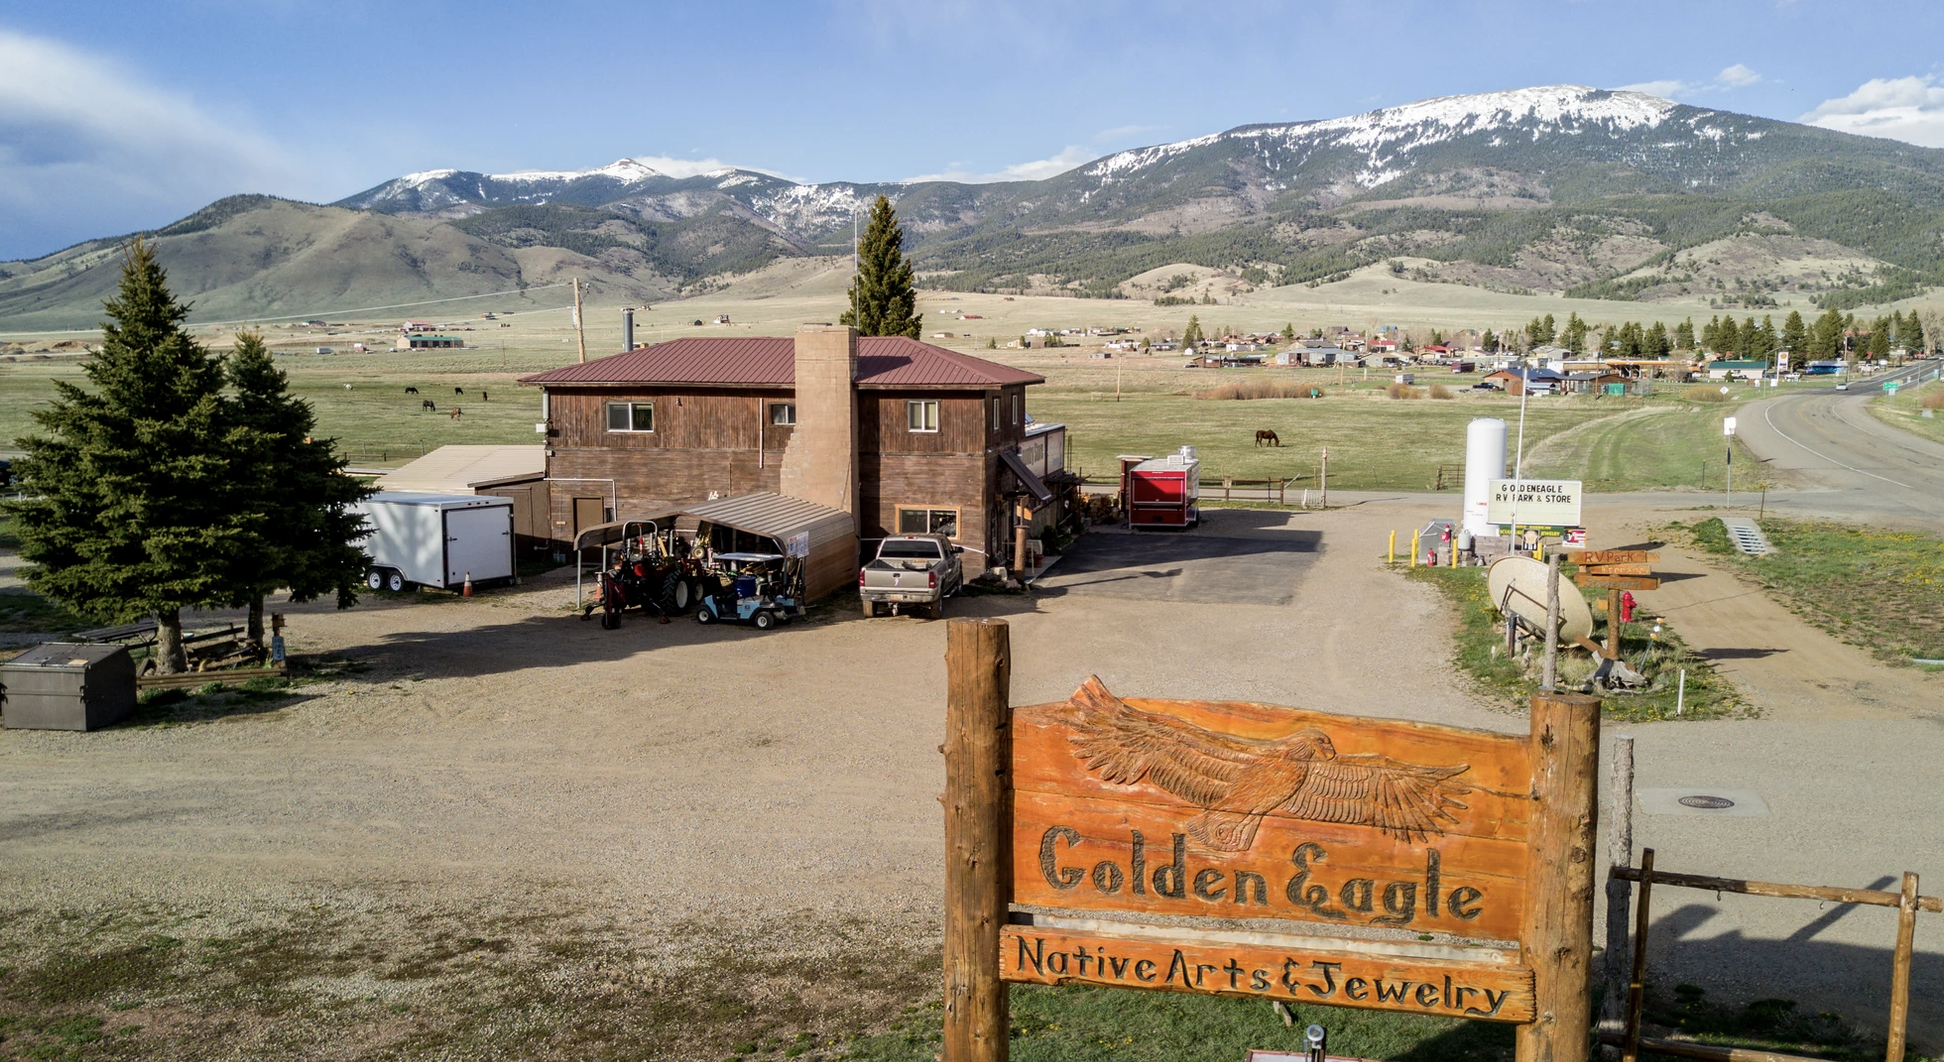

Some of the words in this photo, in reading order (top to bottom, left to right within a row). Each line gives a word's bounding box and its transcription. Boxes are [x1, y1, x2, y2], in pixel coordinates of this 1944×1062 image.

[1496, 493, 1508, 502] RV
[1537, 494, 1542, 503] &
[1545, 495, 1571, 504] STORE
[1584, 551, 1605, 563] RV
[1038, 825, 1270, 906] Golden
[1286, 841, 1485, 925] Eagle
[1016, 935, 1157, 982] Native
[1165, 949, 1272, 993] Arts
[1281, 956, 1301, 997] &
[1306, 960, 1511, 1017] Jewelry
